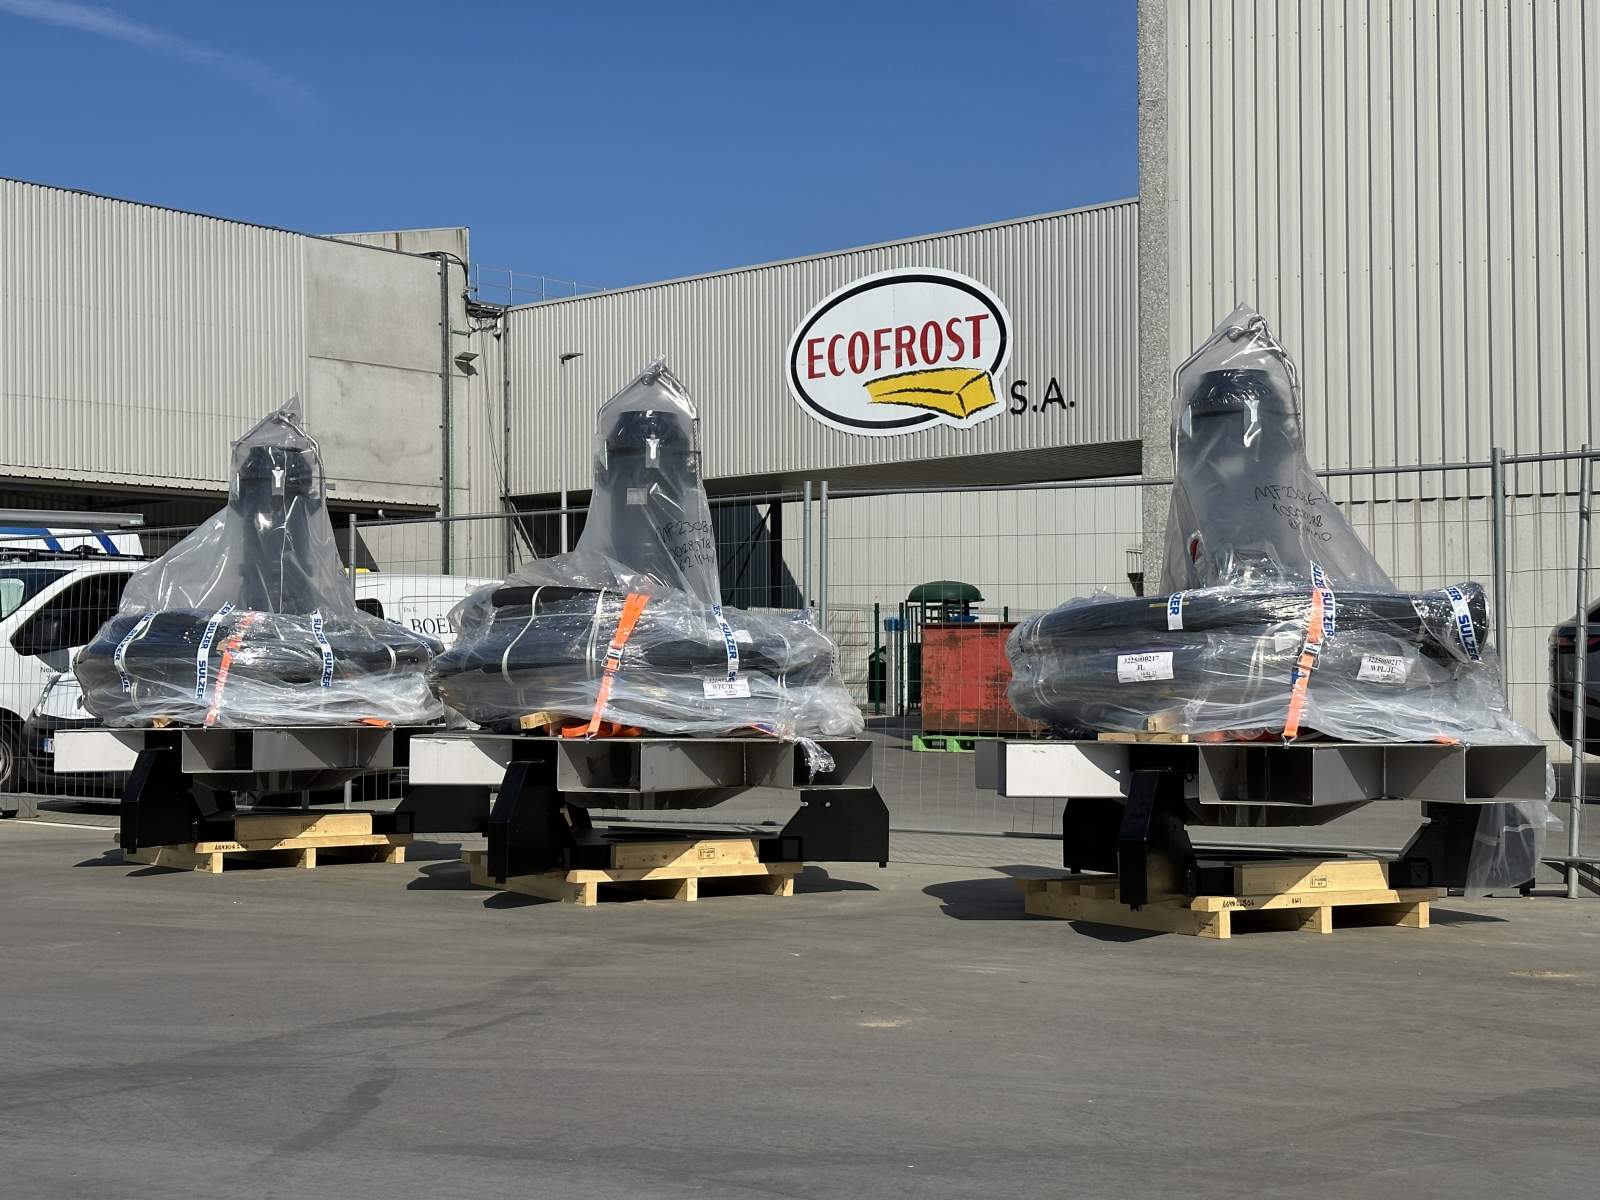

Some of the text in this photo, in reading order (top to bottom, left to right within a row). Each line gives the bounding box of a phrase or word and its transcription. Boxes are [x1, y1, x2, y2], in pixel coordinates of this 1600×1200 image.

[807, 313, 989, 380] ECOFROST
[1010, 377, 1075, 415] S.A.
[200, 620, 217, 650] SULZER
[1321, 592, 1335, 638] SULZER
[719, 622, 738, 660] SULZER
[1457, 614, 1480, 661] SULZER
